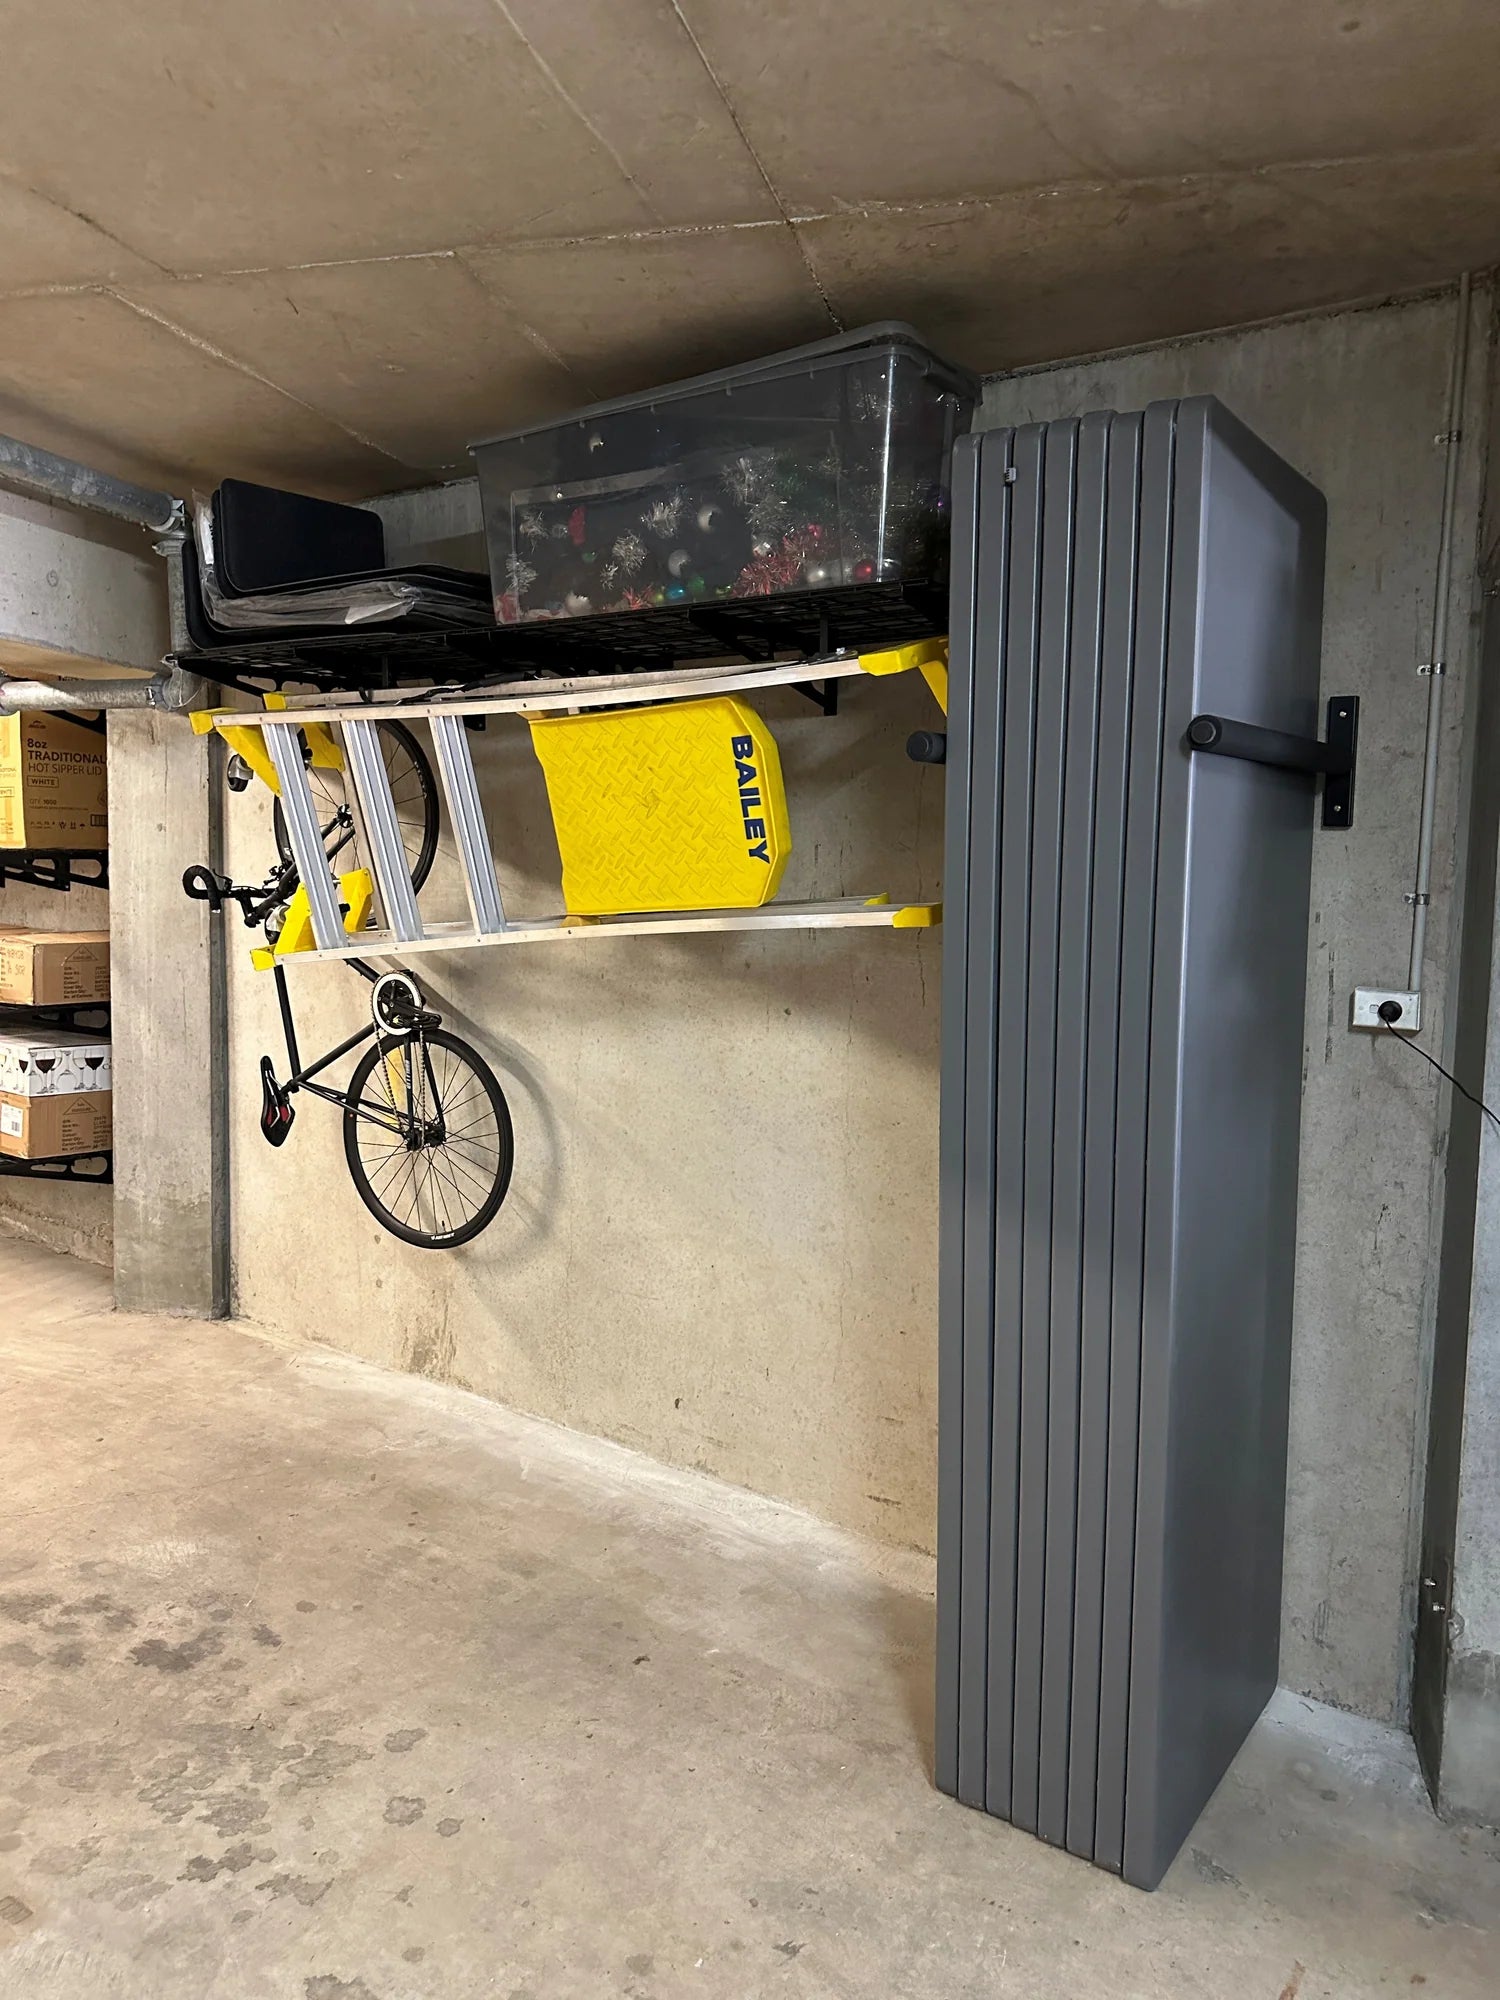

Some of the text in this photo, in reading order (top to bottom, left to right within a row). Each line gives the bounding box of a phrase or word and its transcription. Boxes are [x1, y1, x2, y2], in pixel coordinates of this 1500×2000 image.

[27, 738, 47, 748] 8oz
[27, 751, 106, 764] TRADITIONAL
[28, 763, 49, 773] HOT
[52, 764, 85, 774] SIPPER
[87, 766, 102, 776] LID
[731, 734, 770, 864] BAILEY
